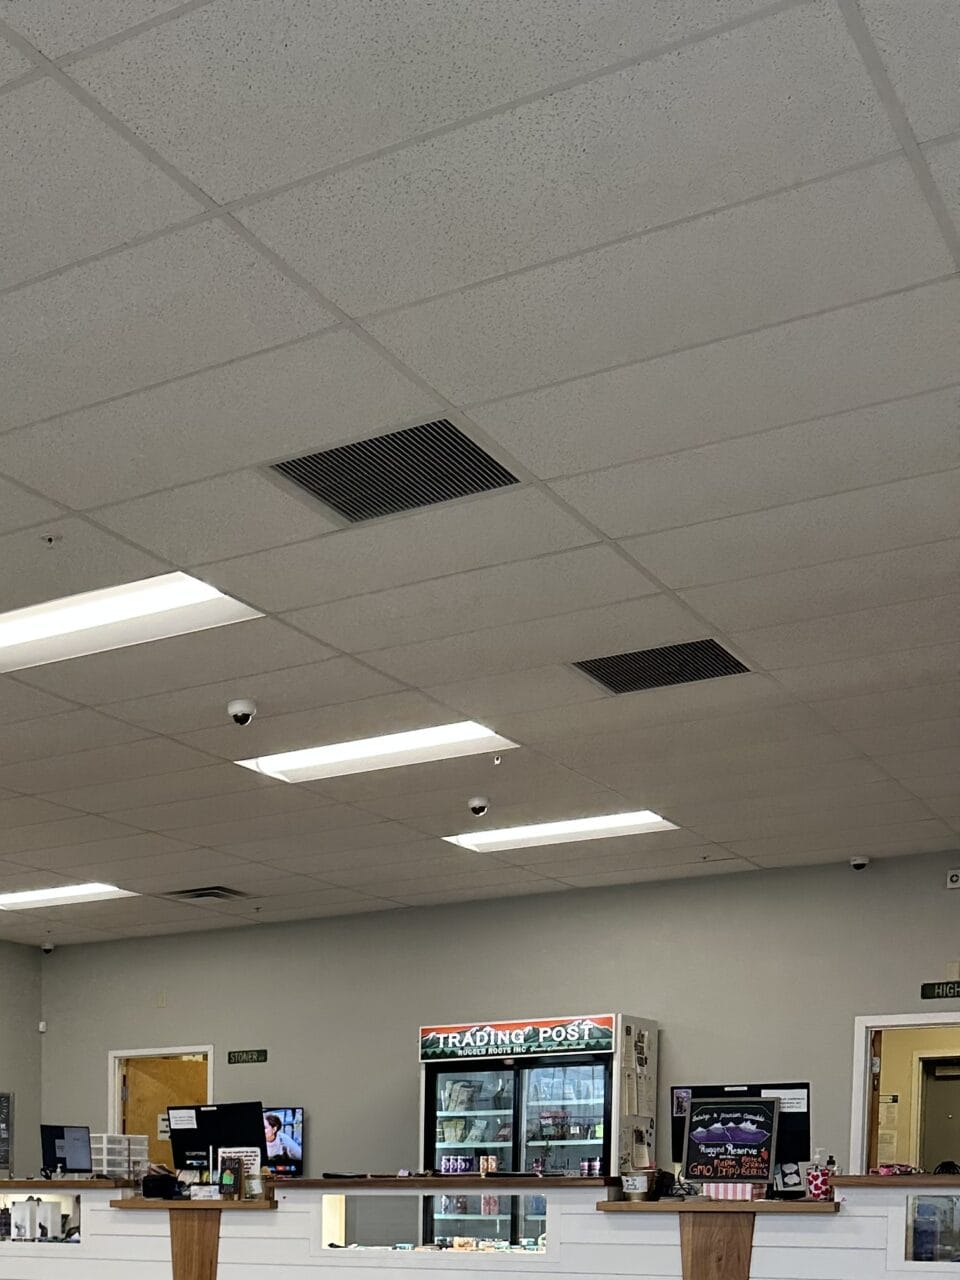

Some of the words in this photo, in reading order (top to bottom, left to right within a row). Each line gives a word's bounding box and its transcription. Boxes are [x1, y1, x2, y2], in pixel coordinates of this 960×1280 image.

[438, 1028, 525, 1048] TRADING
[538, 1024, 593, 1042] POST
[230, 1051, 257, 1063] STONER
[457, 1048, 486, 1056] RUGGED
[488, 1047, 511, 1055] ROOTS
[698, 1144, 725, 1157] Rugged
[725, 1143, 758, 1155] Reserve
